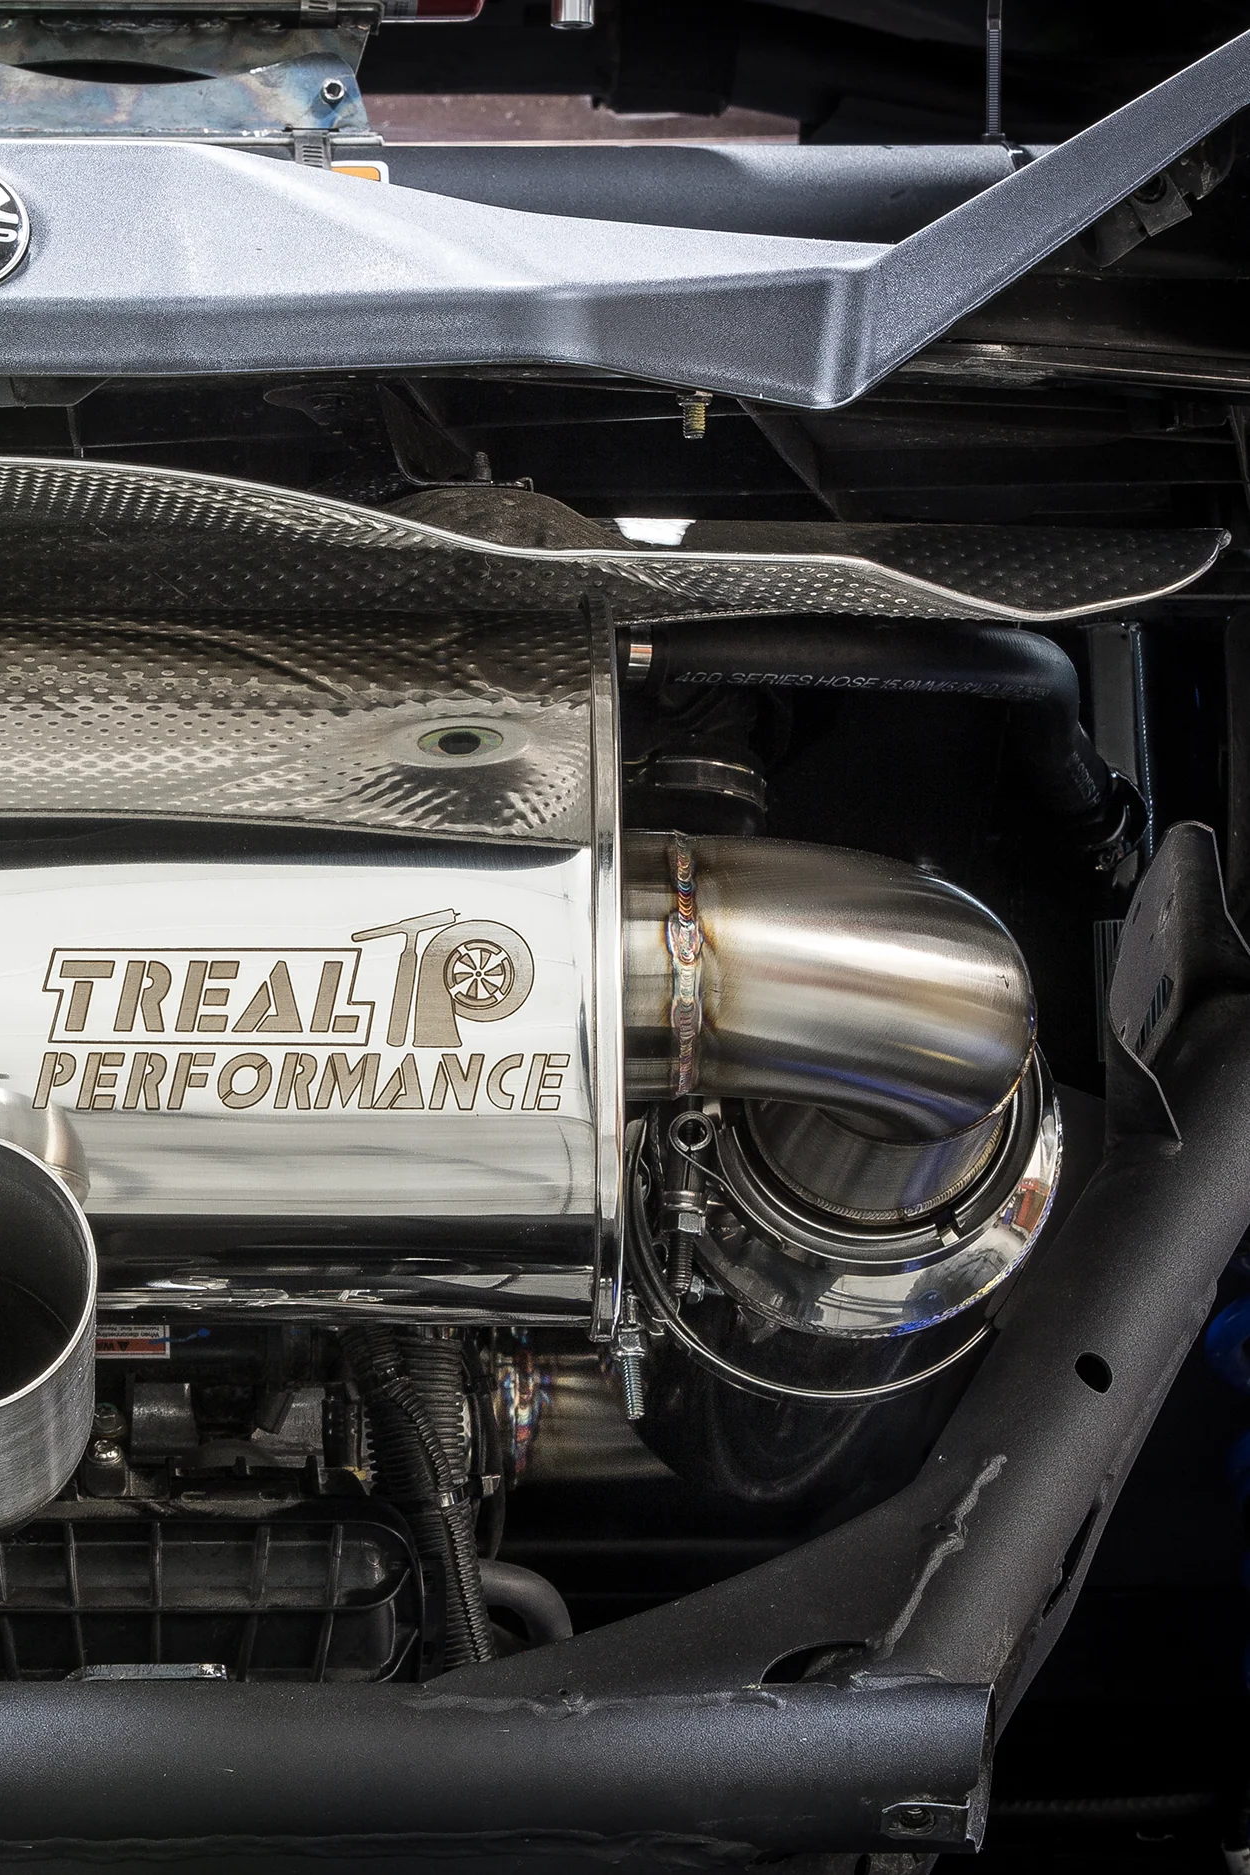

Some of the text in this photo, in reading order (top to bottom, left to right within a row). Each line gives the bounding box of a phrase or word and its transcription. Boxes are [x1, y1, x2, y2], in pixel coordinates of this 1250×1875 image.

[727, 672, 814, 687] SERIES
[815, 675, 880, 690] HOSE
[59, 960, 359, 1033] TREAL
[32, 1052, 570, 1111] PERFORMANCE
